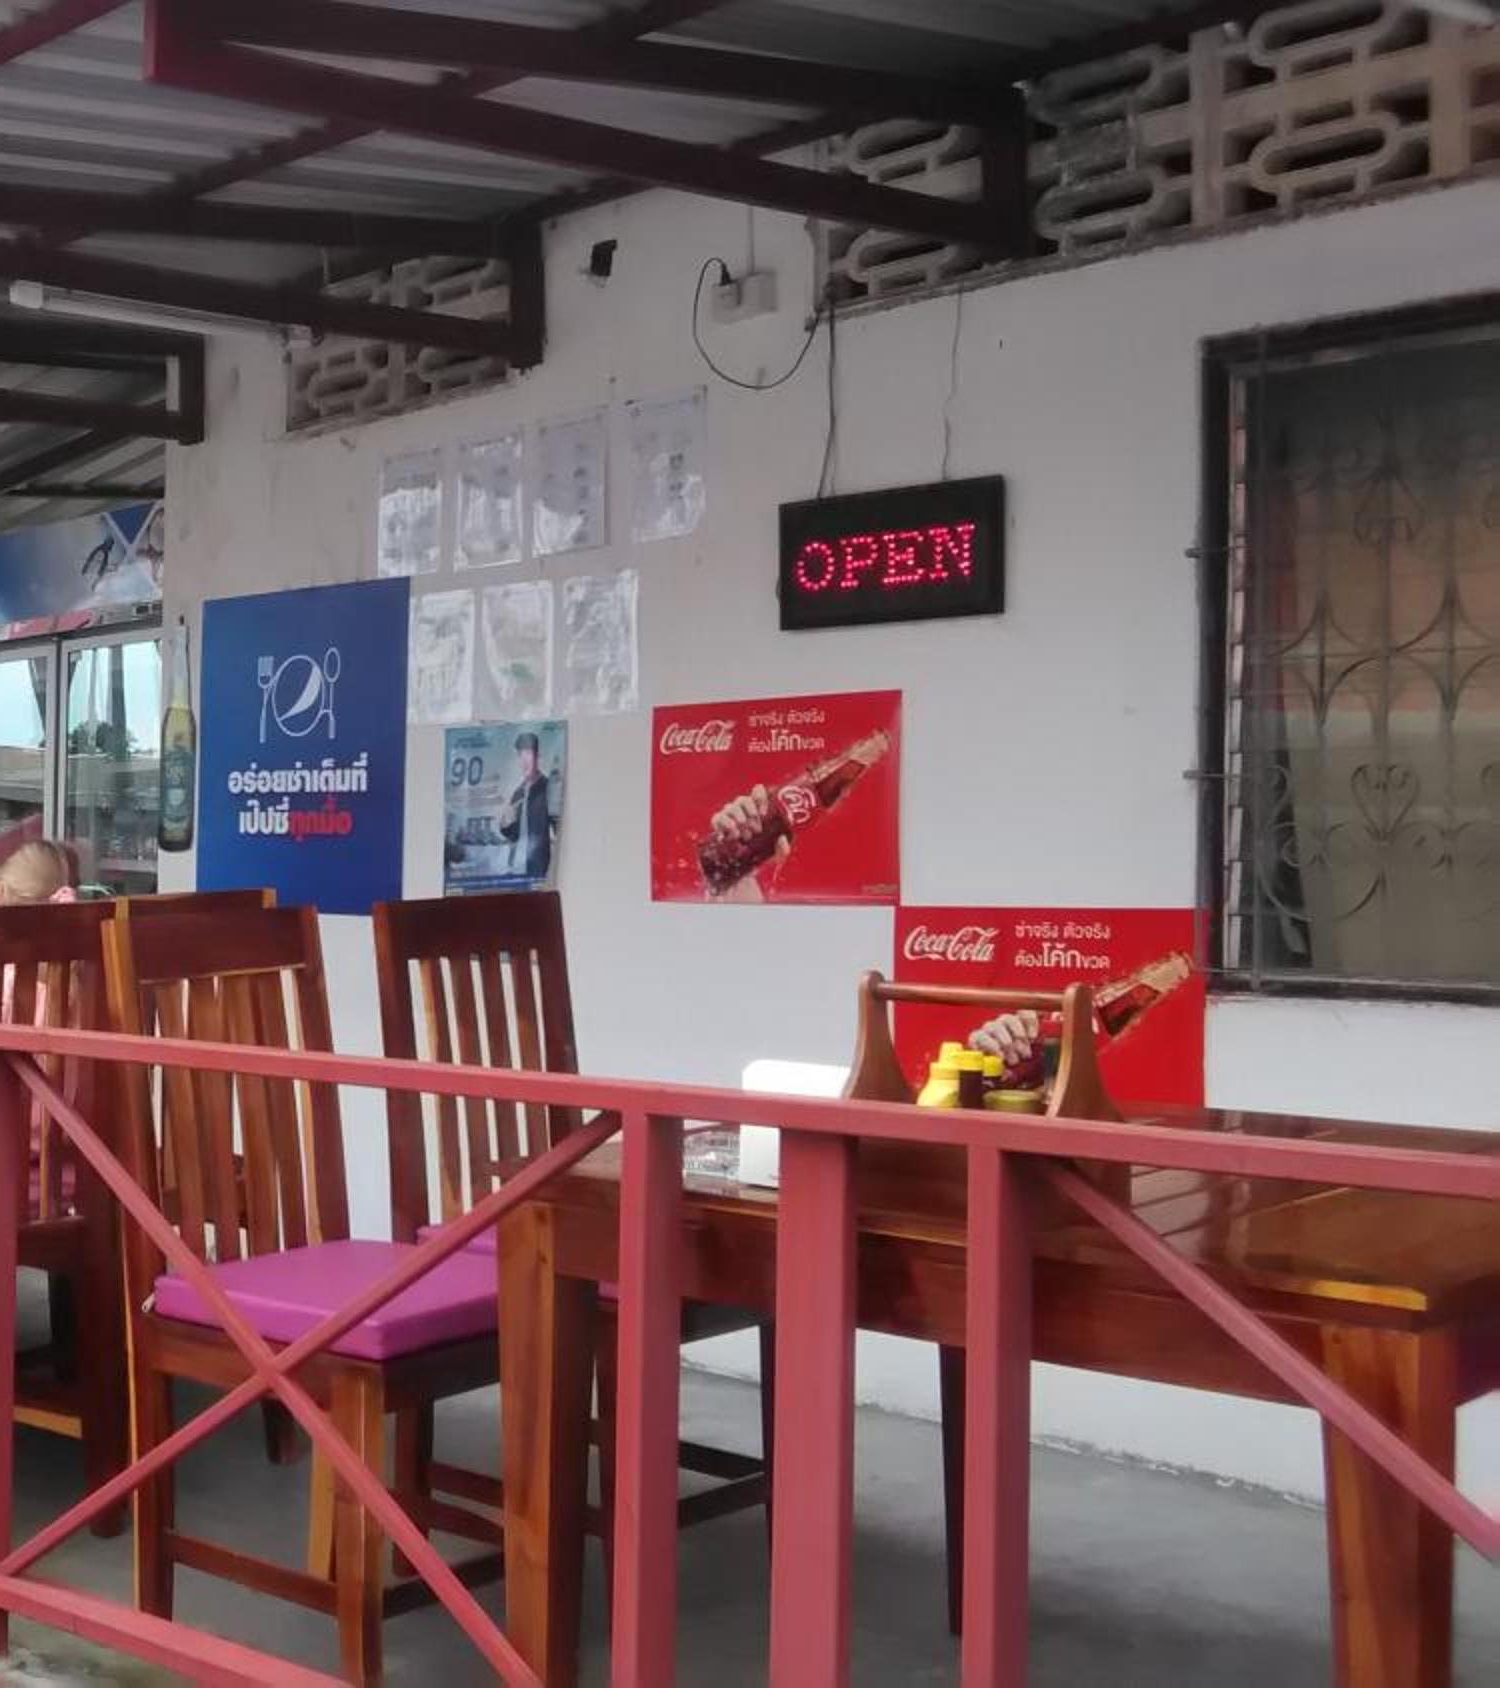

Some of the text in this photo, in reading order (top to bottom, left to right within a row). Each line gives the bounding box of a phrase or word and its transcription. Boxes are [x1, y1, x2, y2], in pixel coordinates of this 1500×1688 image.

[797, 522, 975, 590] OPEN
[660, 719, 736, 755] Coca-Cola
[451, 755, 484, 787] 90
[903, 924, 1000, 962] Coca-Cola
